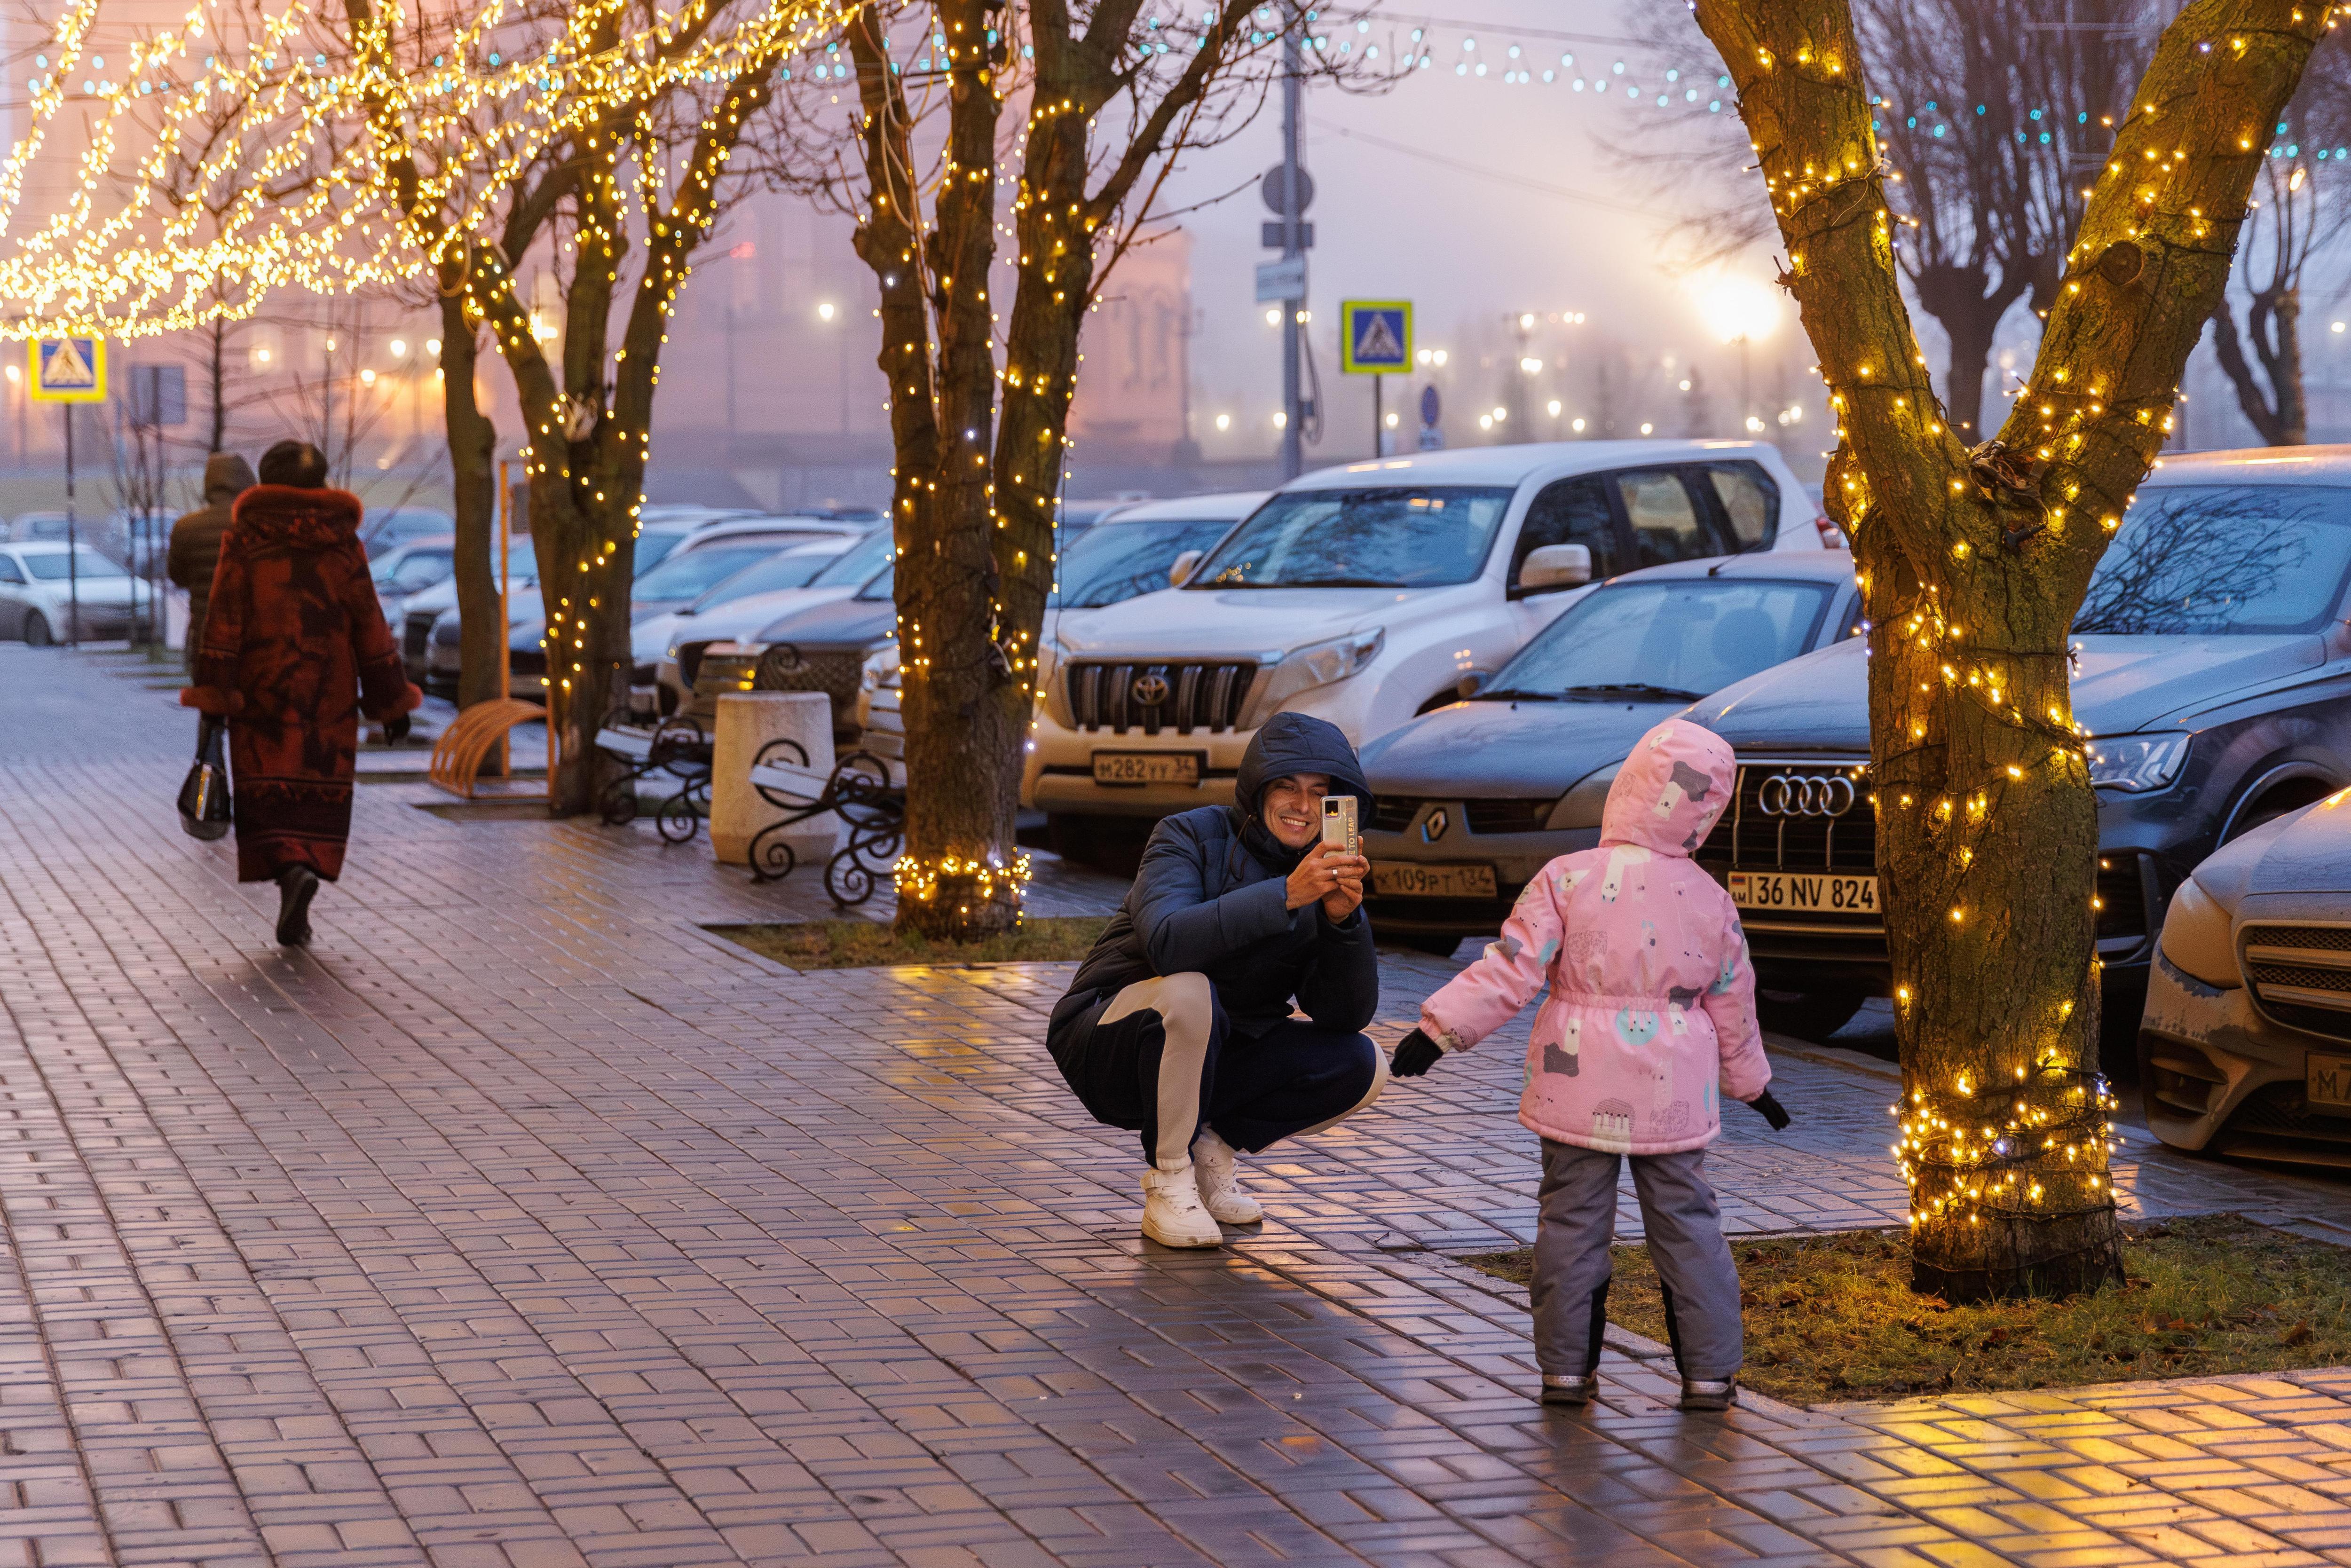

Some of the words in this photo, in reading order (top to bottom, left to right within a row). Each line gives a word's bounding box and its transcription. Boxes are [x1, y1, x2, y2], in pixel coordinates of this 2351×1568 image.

[1349, 838, 1355, 848] TO
[1757, 876, 1783, 905] 36
[1791, 877, 1823, 906] NV
[1831, 879, 1874, 908] 824
